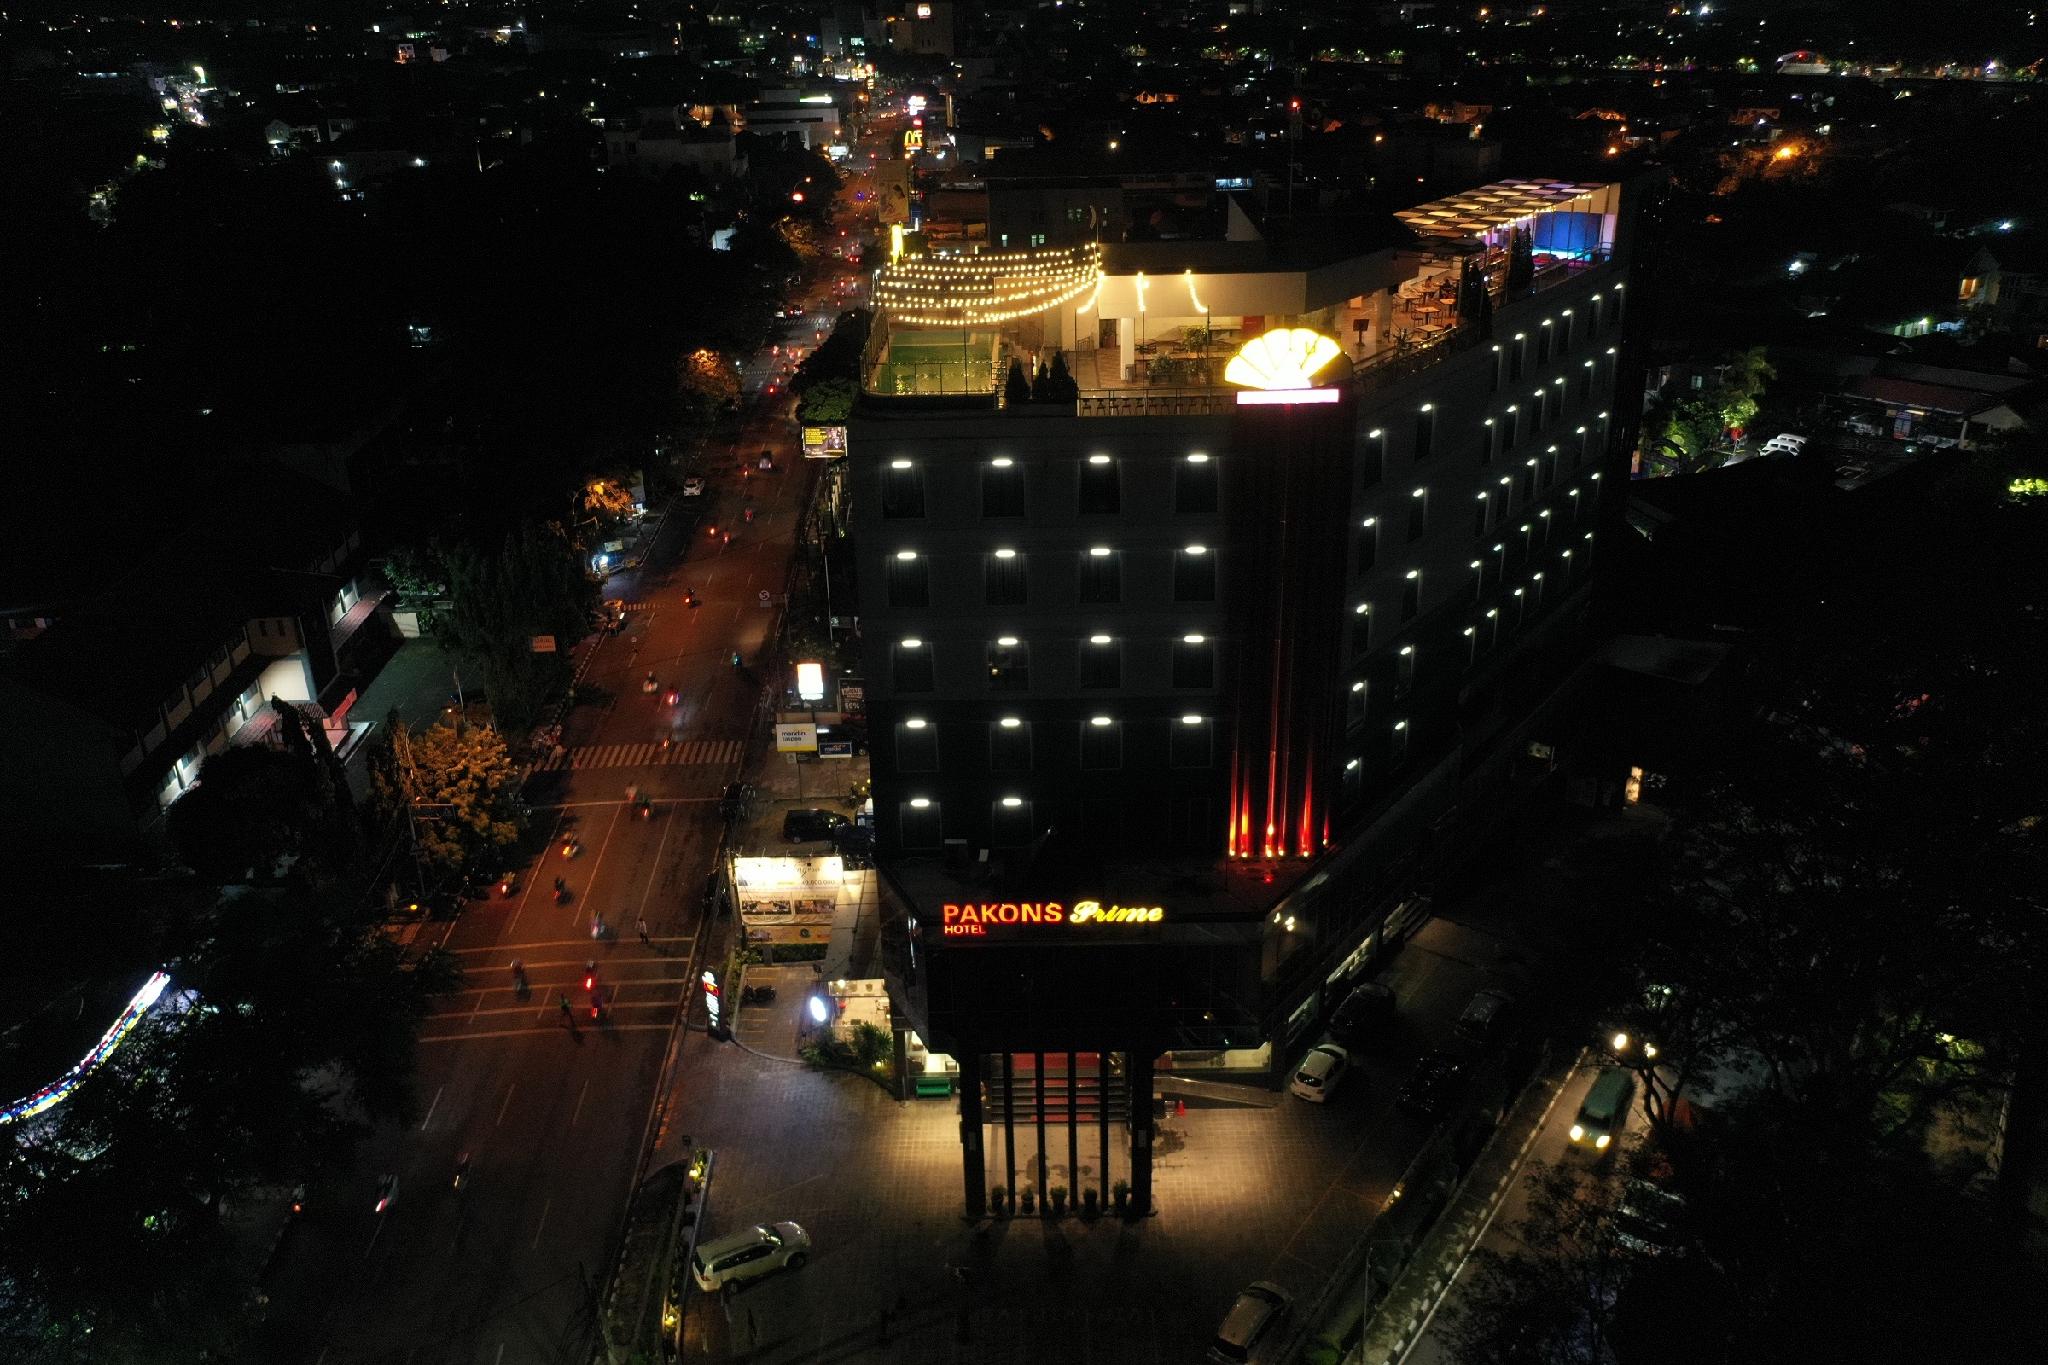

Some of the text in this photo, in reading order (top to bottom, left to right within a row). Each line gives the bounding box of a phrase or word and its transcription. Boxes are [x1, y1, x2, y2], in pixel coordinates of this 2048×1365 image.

[943, 901, 1163, 923] PAKONS Prime
[944, 925, 986, 934] HOTEL
